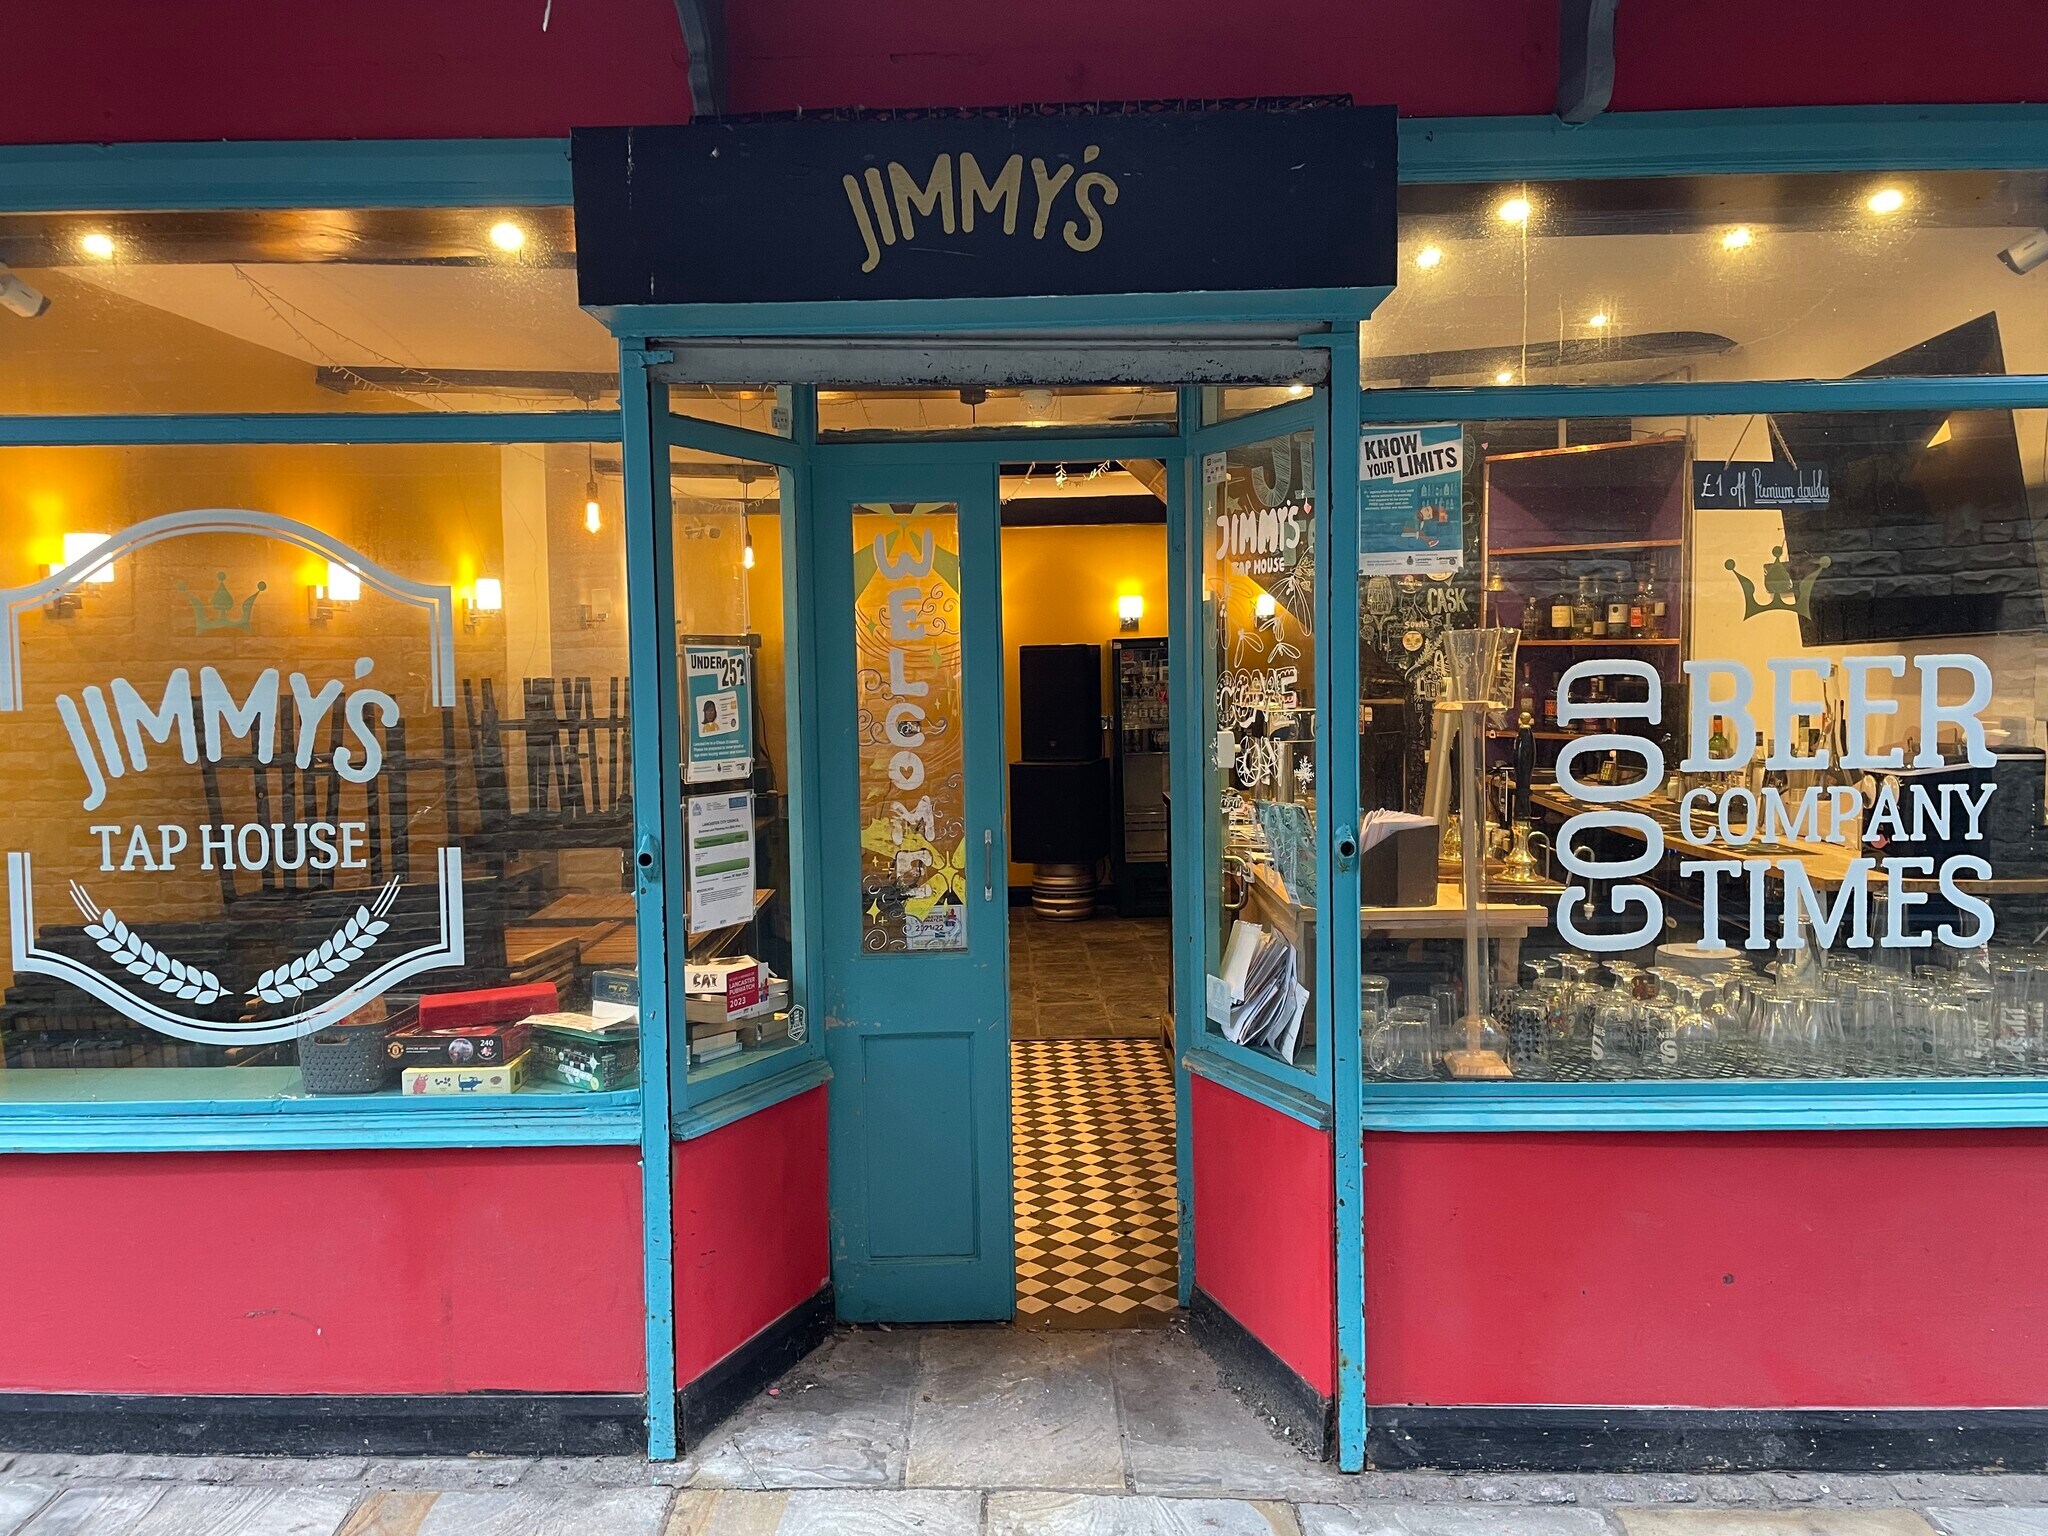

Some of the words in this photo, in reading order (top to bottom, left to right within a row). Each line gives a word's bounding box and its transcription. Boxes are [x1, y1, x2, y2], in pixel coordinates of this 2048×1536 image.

[842, 145, 1119, 274] JIMMY'S
[1365, 434, 1418, 460] KNOW
[1367, 461, 1395, 477] YOUR
[1397, 447, 1458, 477] LIMITS
[1701, 473, 1722, 497] £1
[1730, 471, 1747, 507] off
[1752, 468, 1795, 499] Premium
[1216, 500, 1300, 560] JIMMY'S
[1254, 557, 1285, 575] HOUSE
[1427, 587, 1469, 615] CASK
[691, 655, 722, 669] UNDER
[721, 658, 745, 687] 25?
[873, 527, 937, 901] WELCOME
[1680, 654, 1998, 772] BEER
[56, 657, 400, 811] JIMMY'S
[1556, 658, 1664, 952] GOOD
[1680, 782, 1998, 846] COMPANY
[90, 824, 188, 872] TAP
[200, 822, 367, 870] HOUSE
[1679, 854, 1998, 950] TIMES
[729, 976, 756, 989] LANCASTER
[729, 997, 747, 1008] 2023
[480, 1039, 494, 1047] 240
